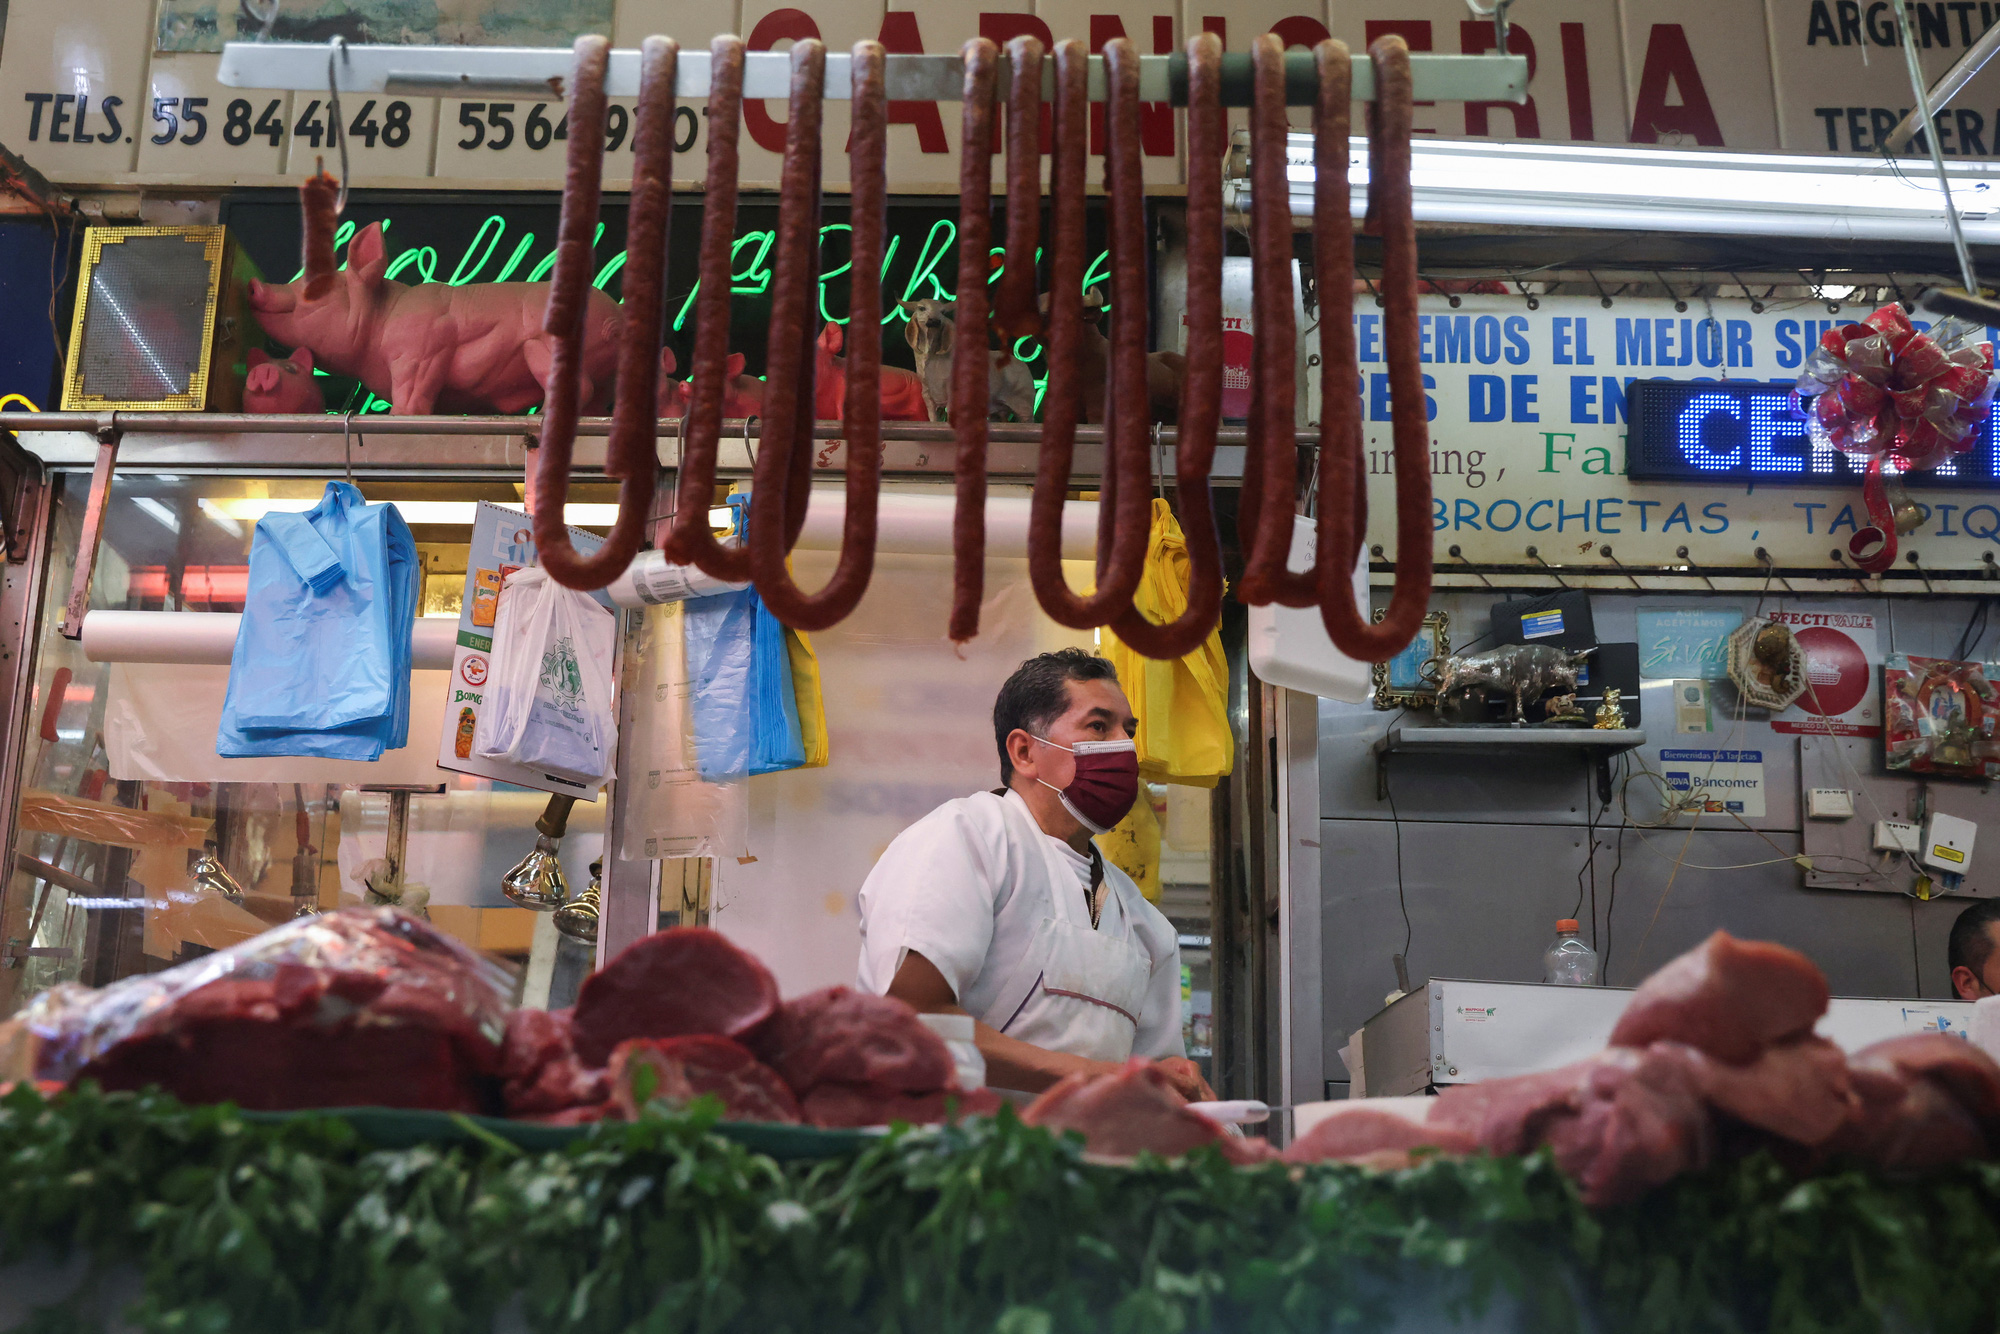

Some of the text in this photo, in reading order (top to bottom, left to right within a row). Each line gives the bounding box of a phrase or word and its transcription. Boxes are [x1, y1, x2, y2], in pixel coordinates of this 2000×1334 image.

[25, 93, 132, 144] TELS.
[151, 98, 208, 146] 55
[223, 98, 283, 147] 84
[349, 100, 412, 148] 48
[458, 103, 515, 150] 55
[1552, 317, 1595, 366] EL
[1615, 317, 1753, 368] MEJOR
[1468, 374, 1540, 424] DE
[1655, 618, 1726, 628] ACEPTAMOS
[1769, 612, 1875, 630] EFECTIVALE
[469, 635, 491, 651] ENER
[1664, 750, 1711, 760] Bienvenidas
[1667, 776, 1758, 788] BBVA Bancomer
